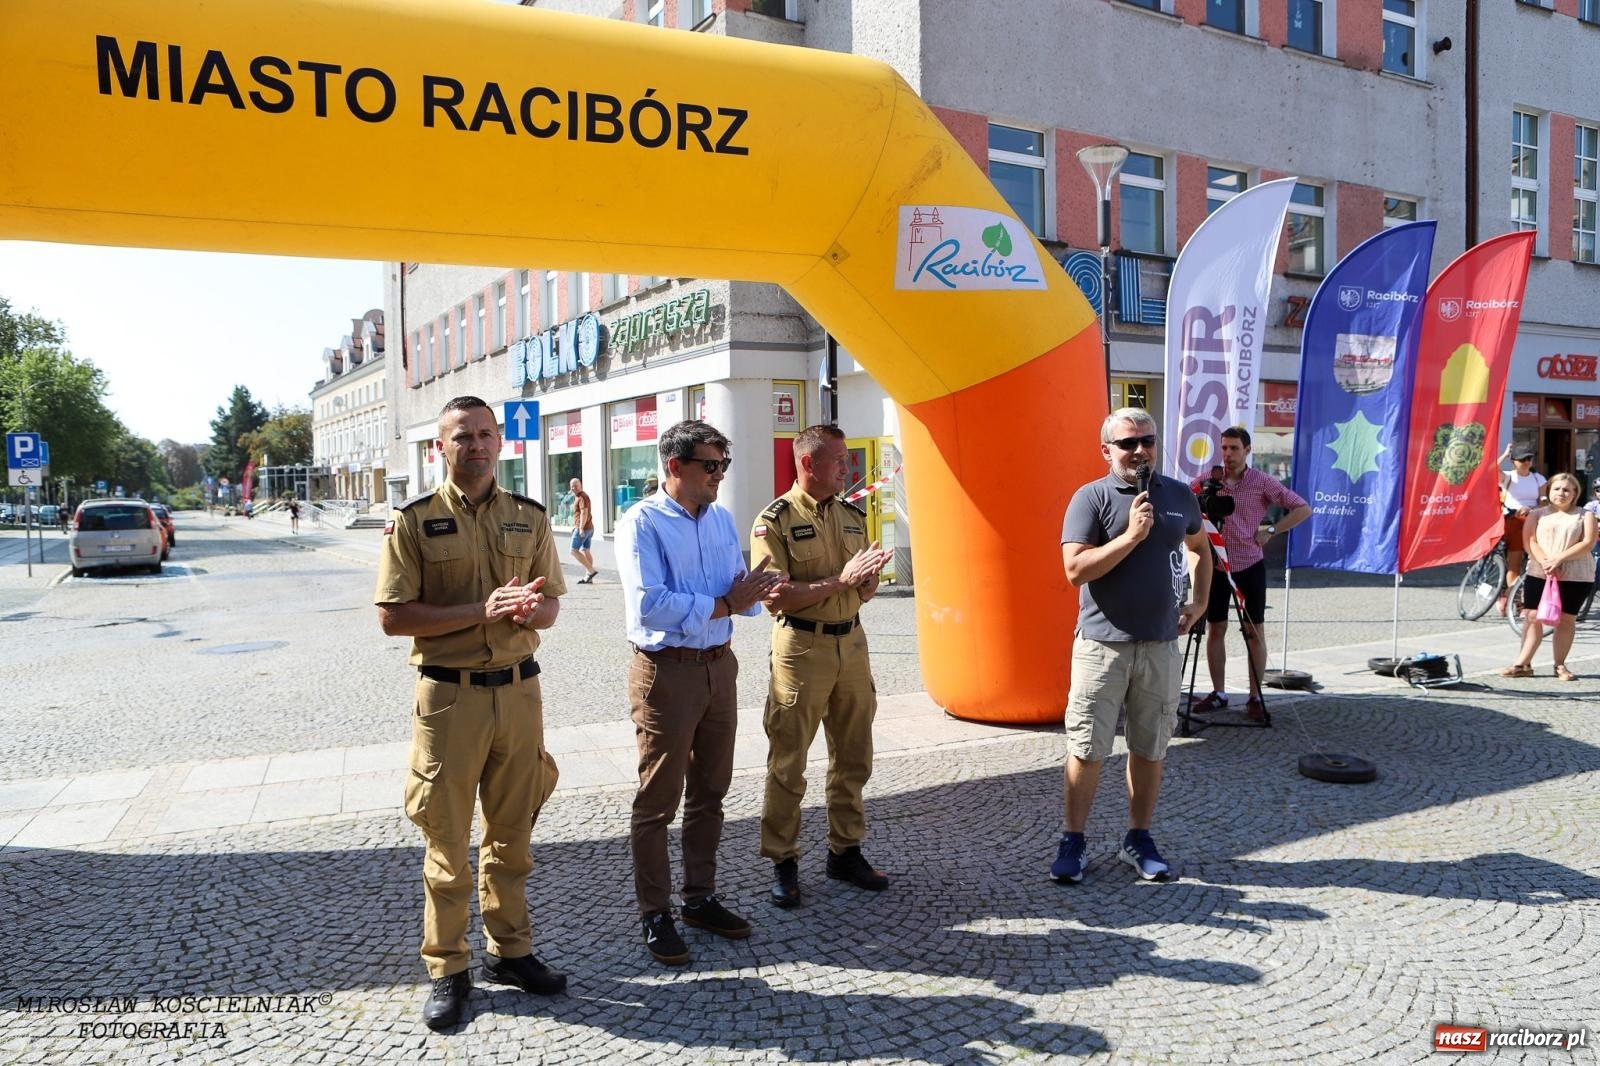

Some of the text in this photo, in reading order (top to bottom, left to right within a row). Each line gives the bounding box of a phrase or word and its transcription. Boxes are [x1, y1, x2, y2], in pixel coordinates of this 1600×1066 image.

[95, 34, 750, 157] MIASTO RACIBÓRZ
[912, 238, 1040, 289] Racibórz
[1367, 290, 1419, 304] Racibórz
[1466, 299, 1519, 310] Racibórz
[608, 288, 711, 353] zaprasza
[508, 312, 600, 389] BOLKO
[1235, 305, 1257, 411] RACIBÓRZ
[14, 436, 34, 459] P
[1312, 505, 1327, 514] od
[1314, 491, 1351, 506] Dodaj
[1420, 493, 1454, 505] Dodaj
